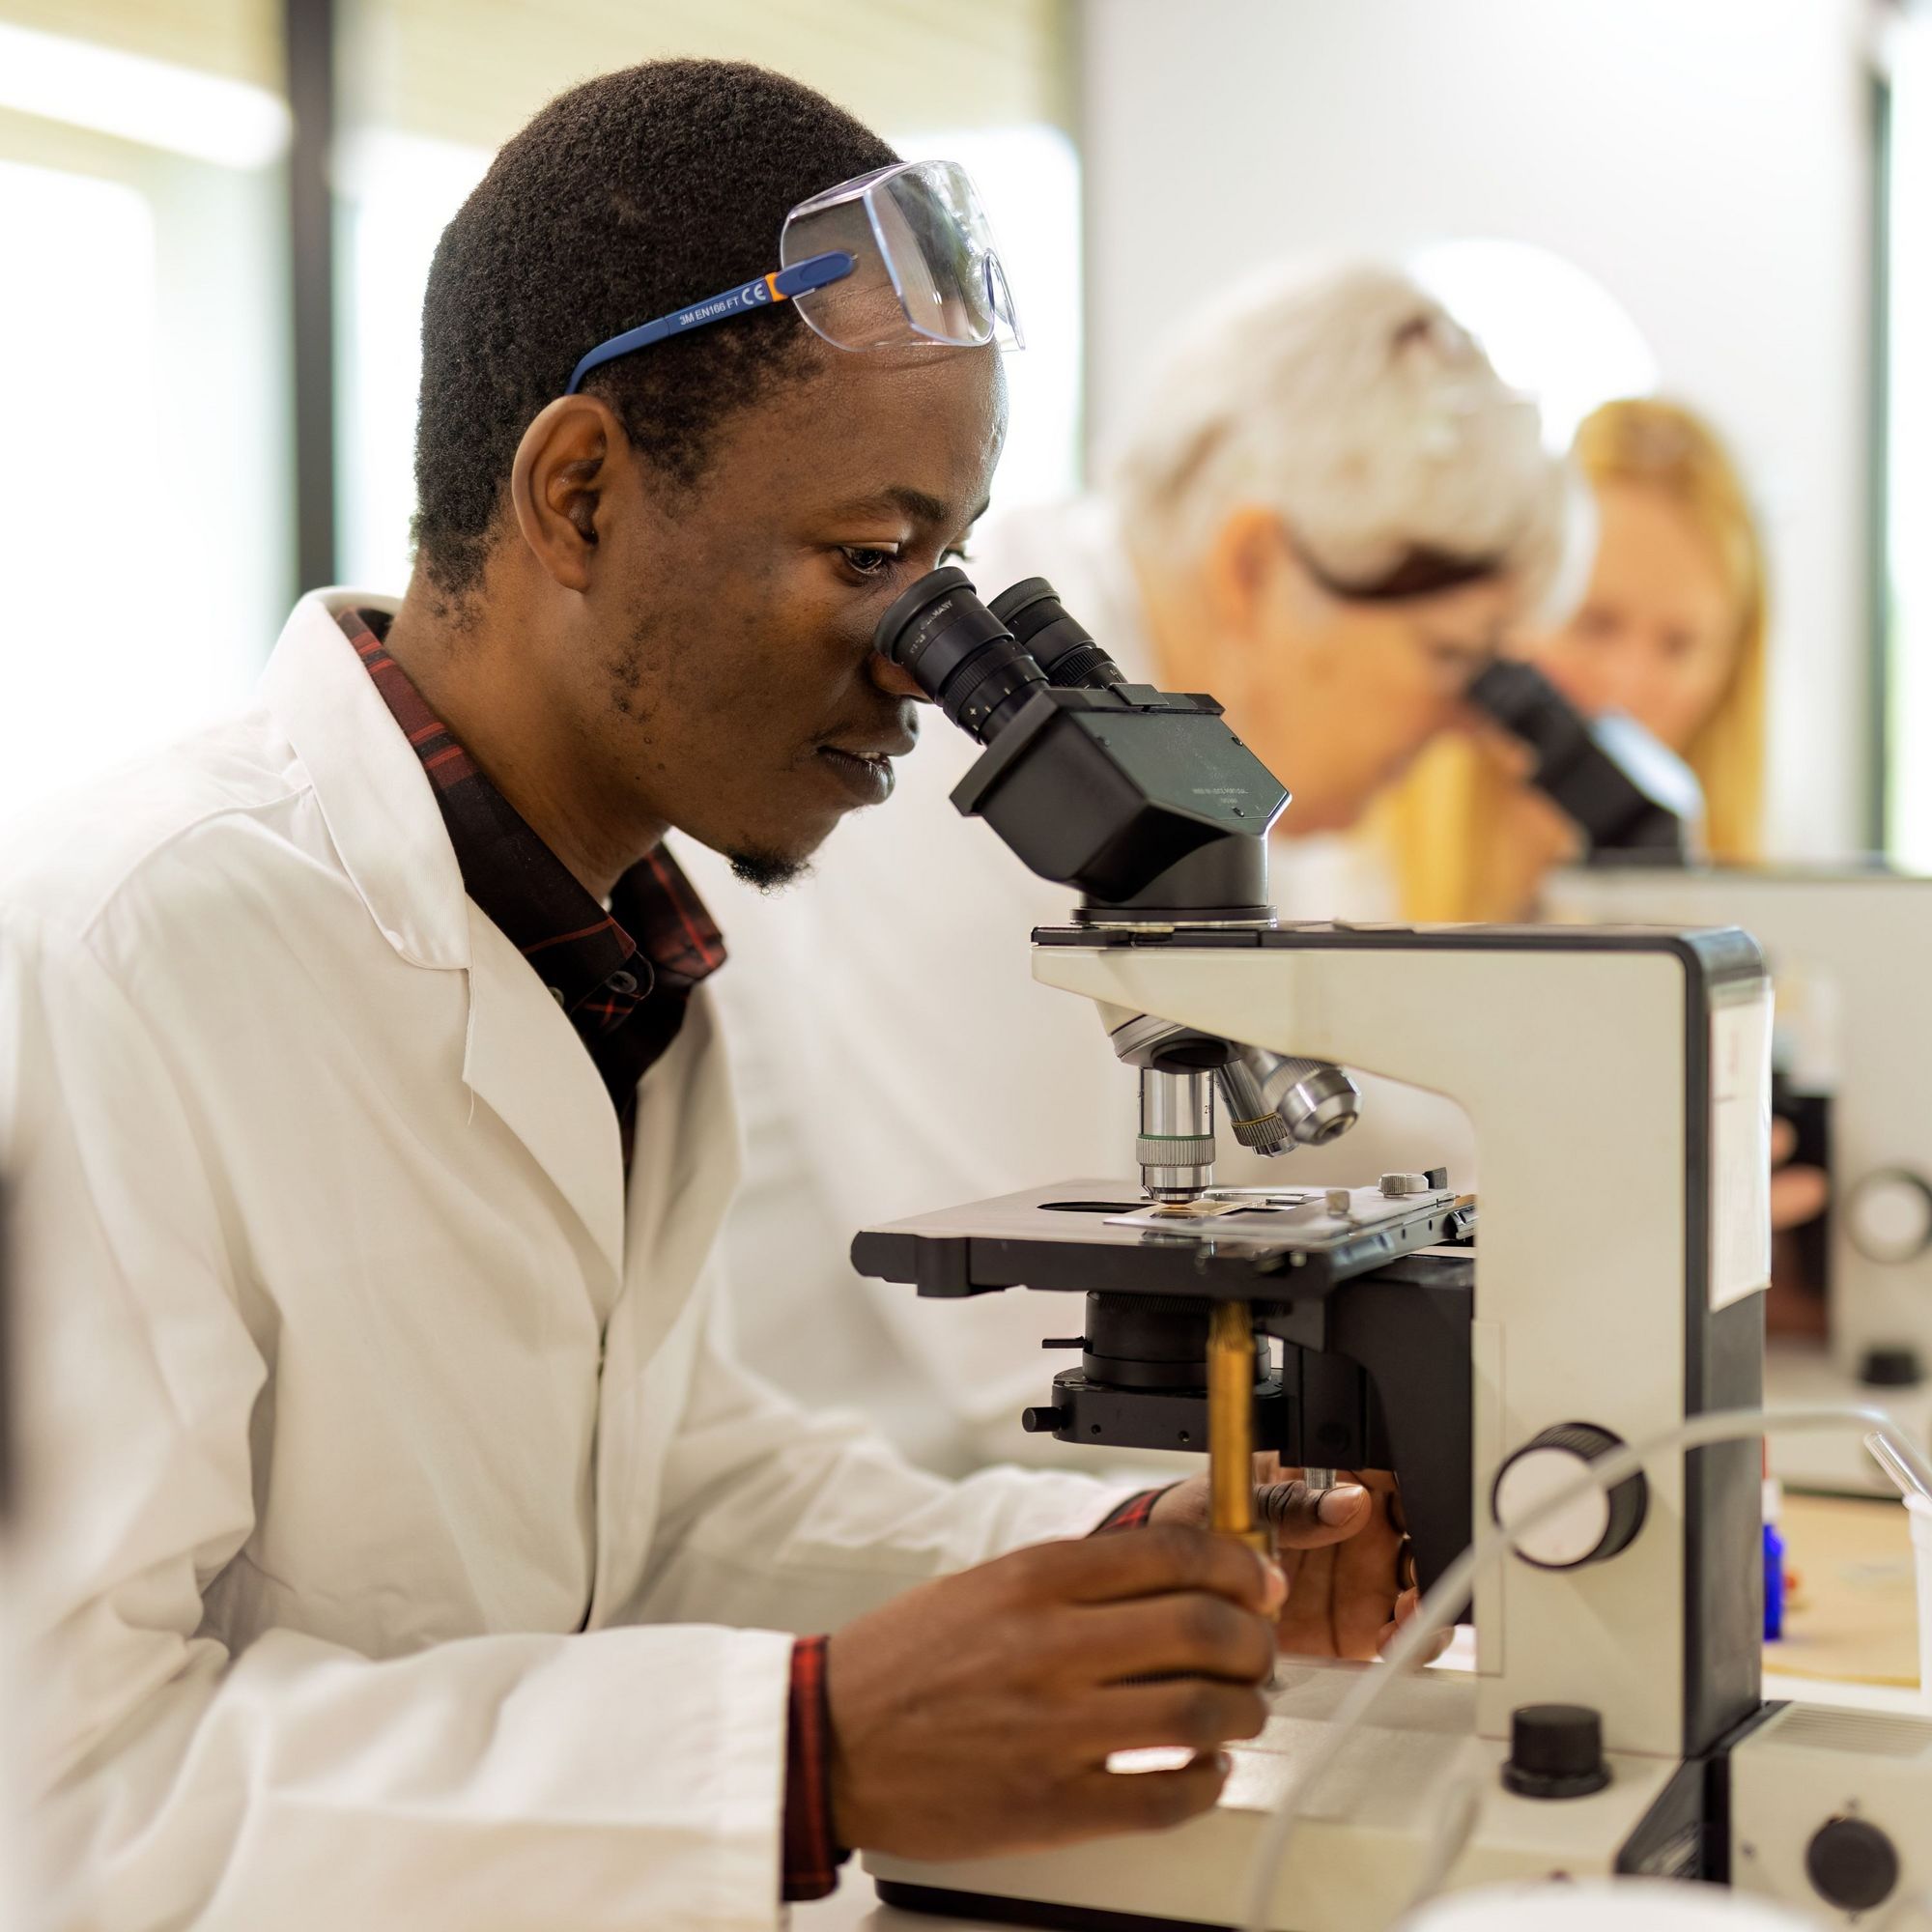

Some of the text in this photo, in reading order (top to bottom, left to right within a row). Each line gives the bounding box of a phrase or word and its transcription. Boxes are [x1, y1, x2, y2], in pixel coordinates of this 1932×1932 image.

[679, 283, 766, 326] 3M EN166 FT CE
